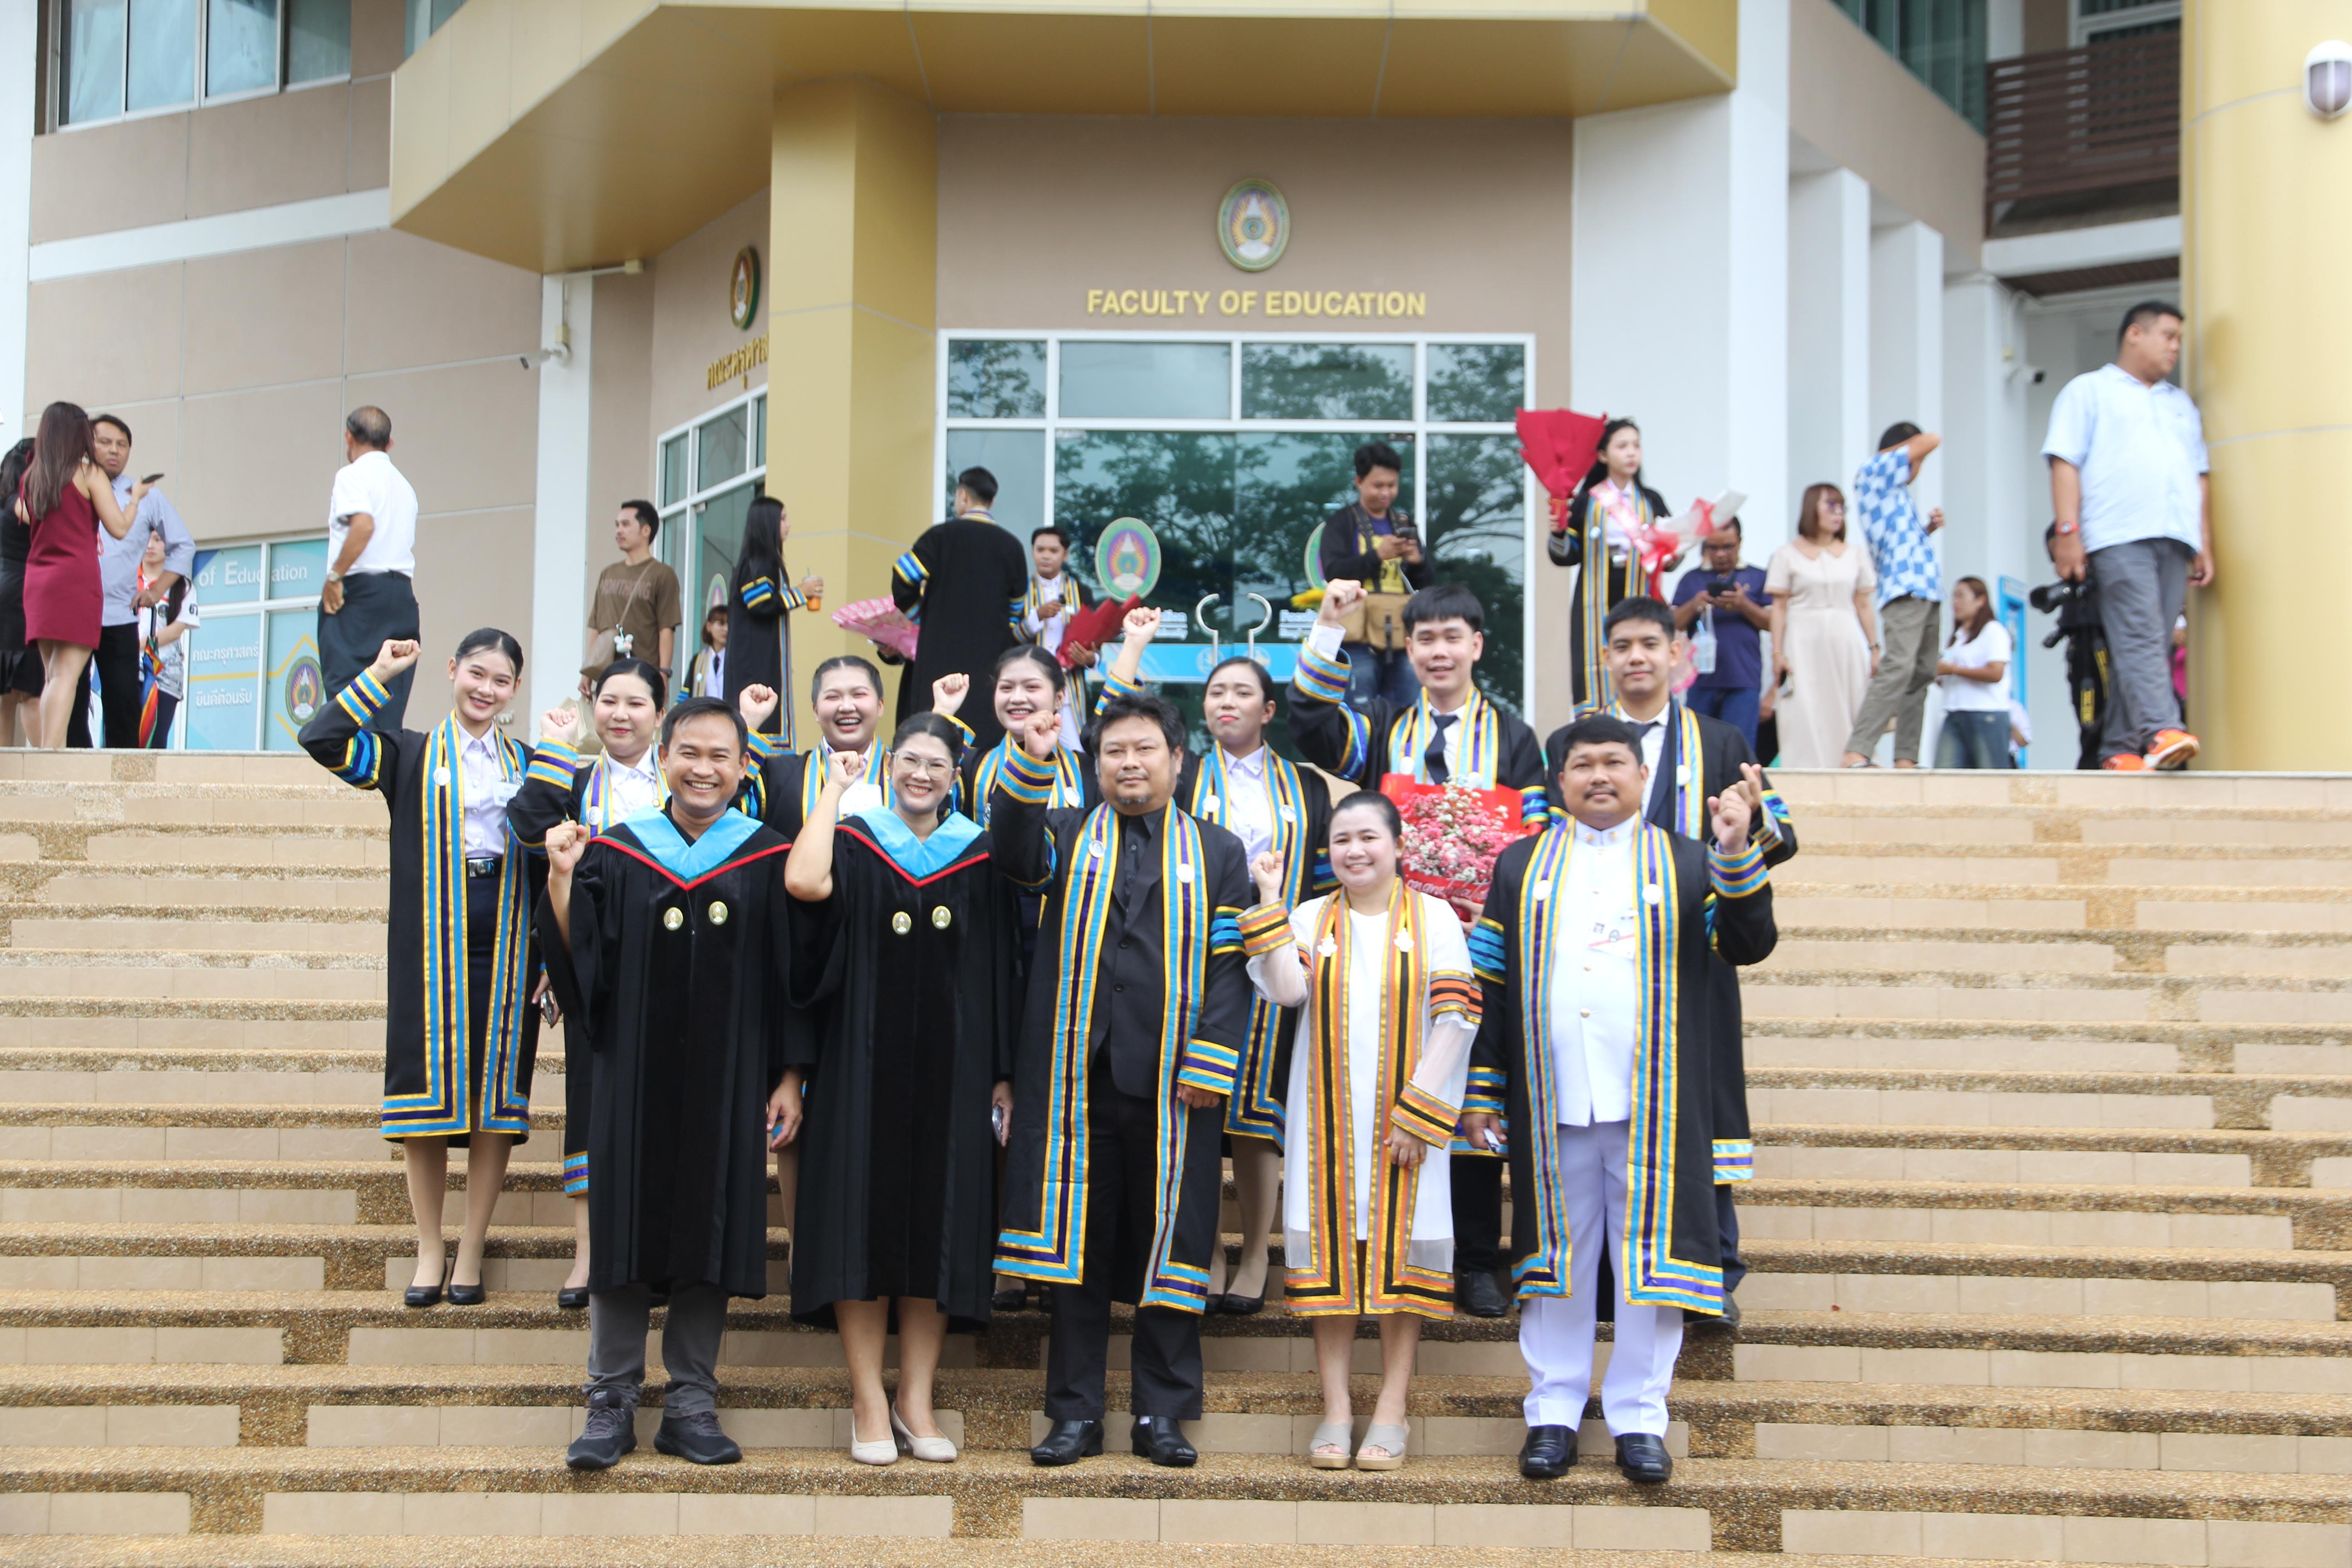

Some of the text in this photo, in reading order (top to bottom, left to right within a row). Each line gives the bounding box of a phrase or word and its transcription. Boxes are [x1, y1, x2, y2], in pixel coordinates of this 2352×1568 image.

[1088, 289, 1426, 317] FACULTY OF EDUCATION
[198, 567, 216, 587] of
